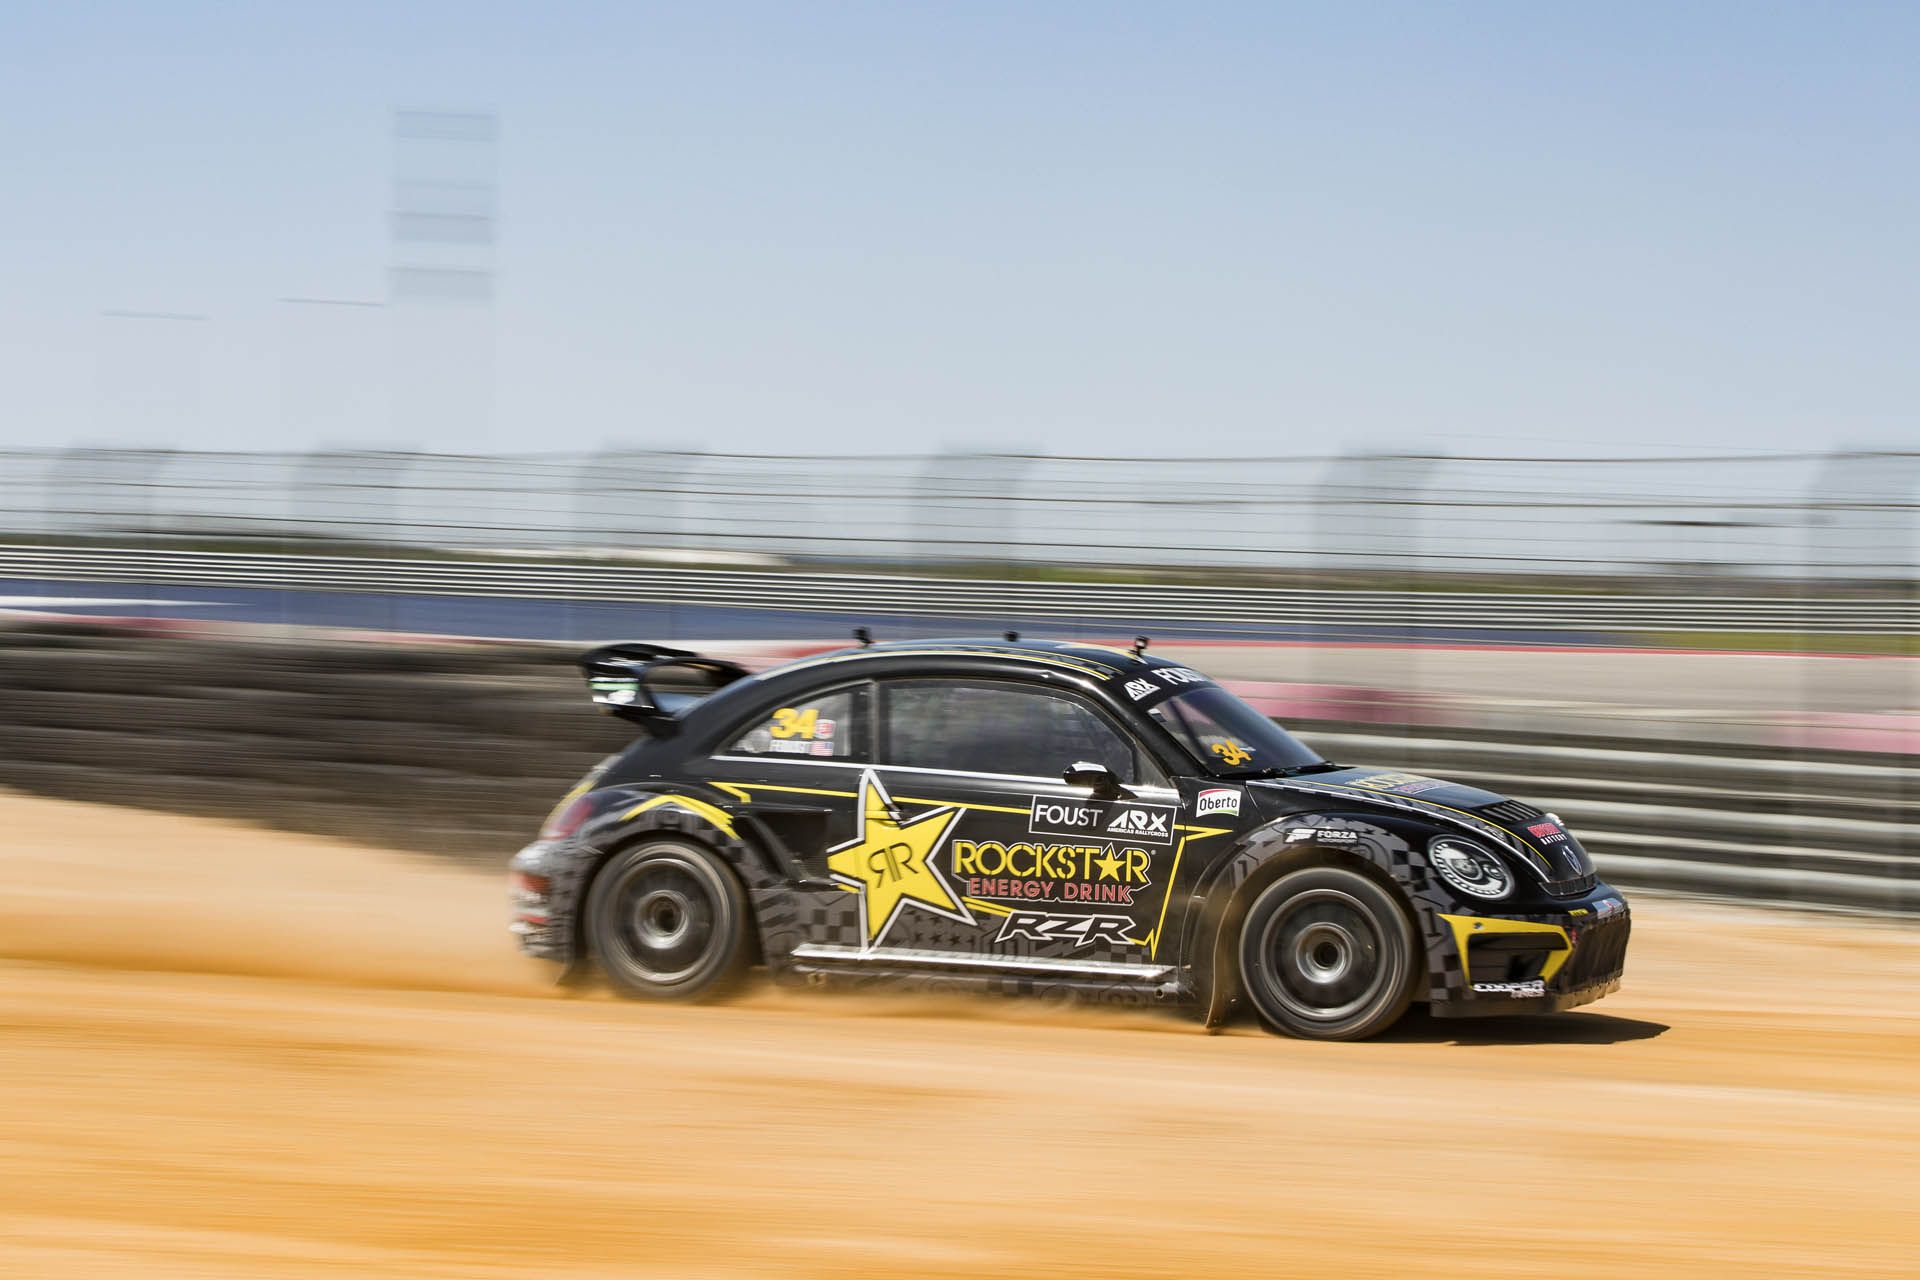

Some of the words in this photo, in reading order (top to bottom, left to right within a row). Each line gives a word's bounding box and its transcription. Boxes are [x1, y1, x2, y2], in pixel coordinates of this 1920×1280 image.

[1124, 678, 1160, 700] ARX
[769, 708, 819, 739] 34
[1212, 739, 1252, 766] 34
[1199, 797, 1238, 811] Oberto
[1034, 804, 1104, 827] FOUST
[1108, 810, 1168, 832] ARX
[1134, 829, 1169, 838] RALLYCROSS
[1316, 830, 1358, 840] FORZA
[955, 842, 1148, 884] ROCKSTAR
[968, 877, 1054, 899] ENERGY
[1063, 884, 1131, 904] DRINK
[995, 911, 1136, 947] RZR
